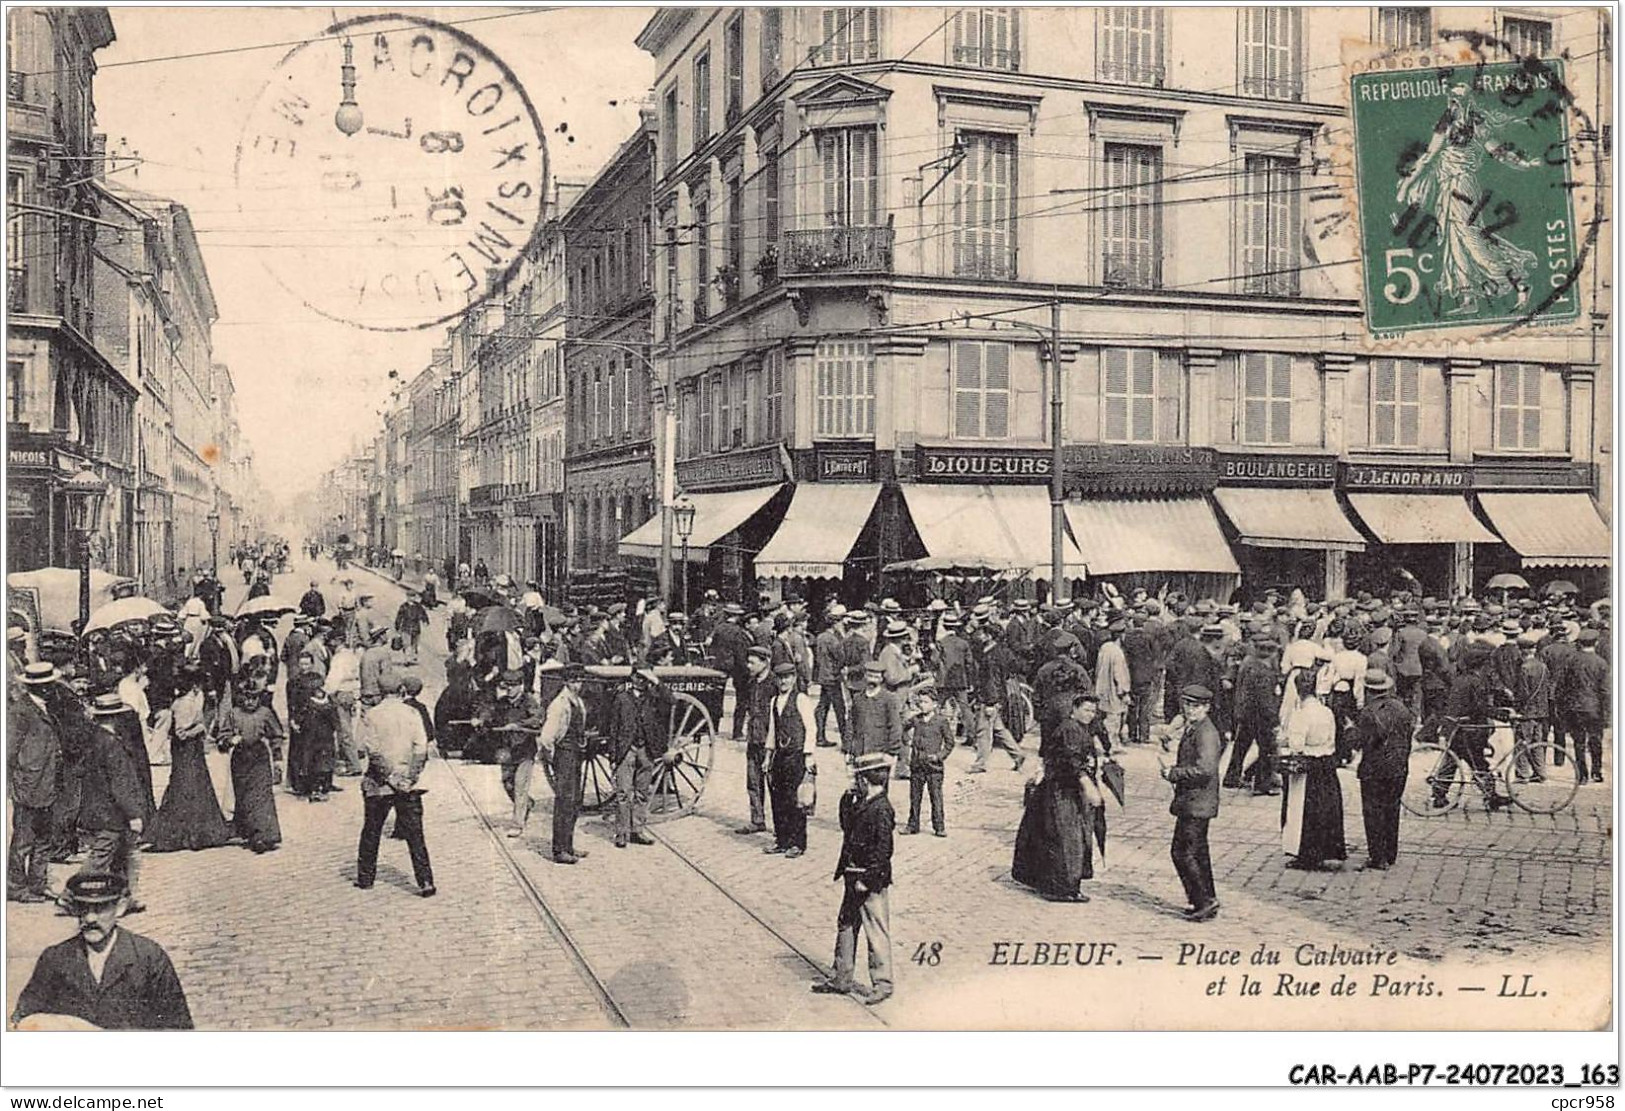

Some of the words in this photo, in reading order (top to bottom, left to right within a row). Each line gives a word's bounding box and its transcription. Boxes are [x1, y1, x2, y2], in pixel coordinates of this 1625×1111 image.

[928, 456, 1050, 474] LIQUEURS
[1226, 461, 1333, 477] BOULANGERIE
[1354, 474, 1368, 485] J.
[1370, 471, 1463, 486] LENORMAND
